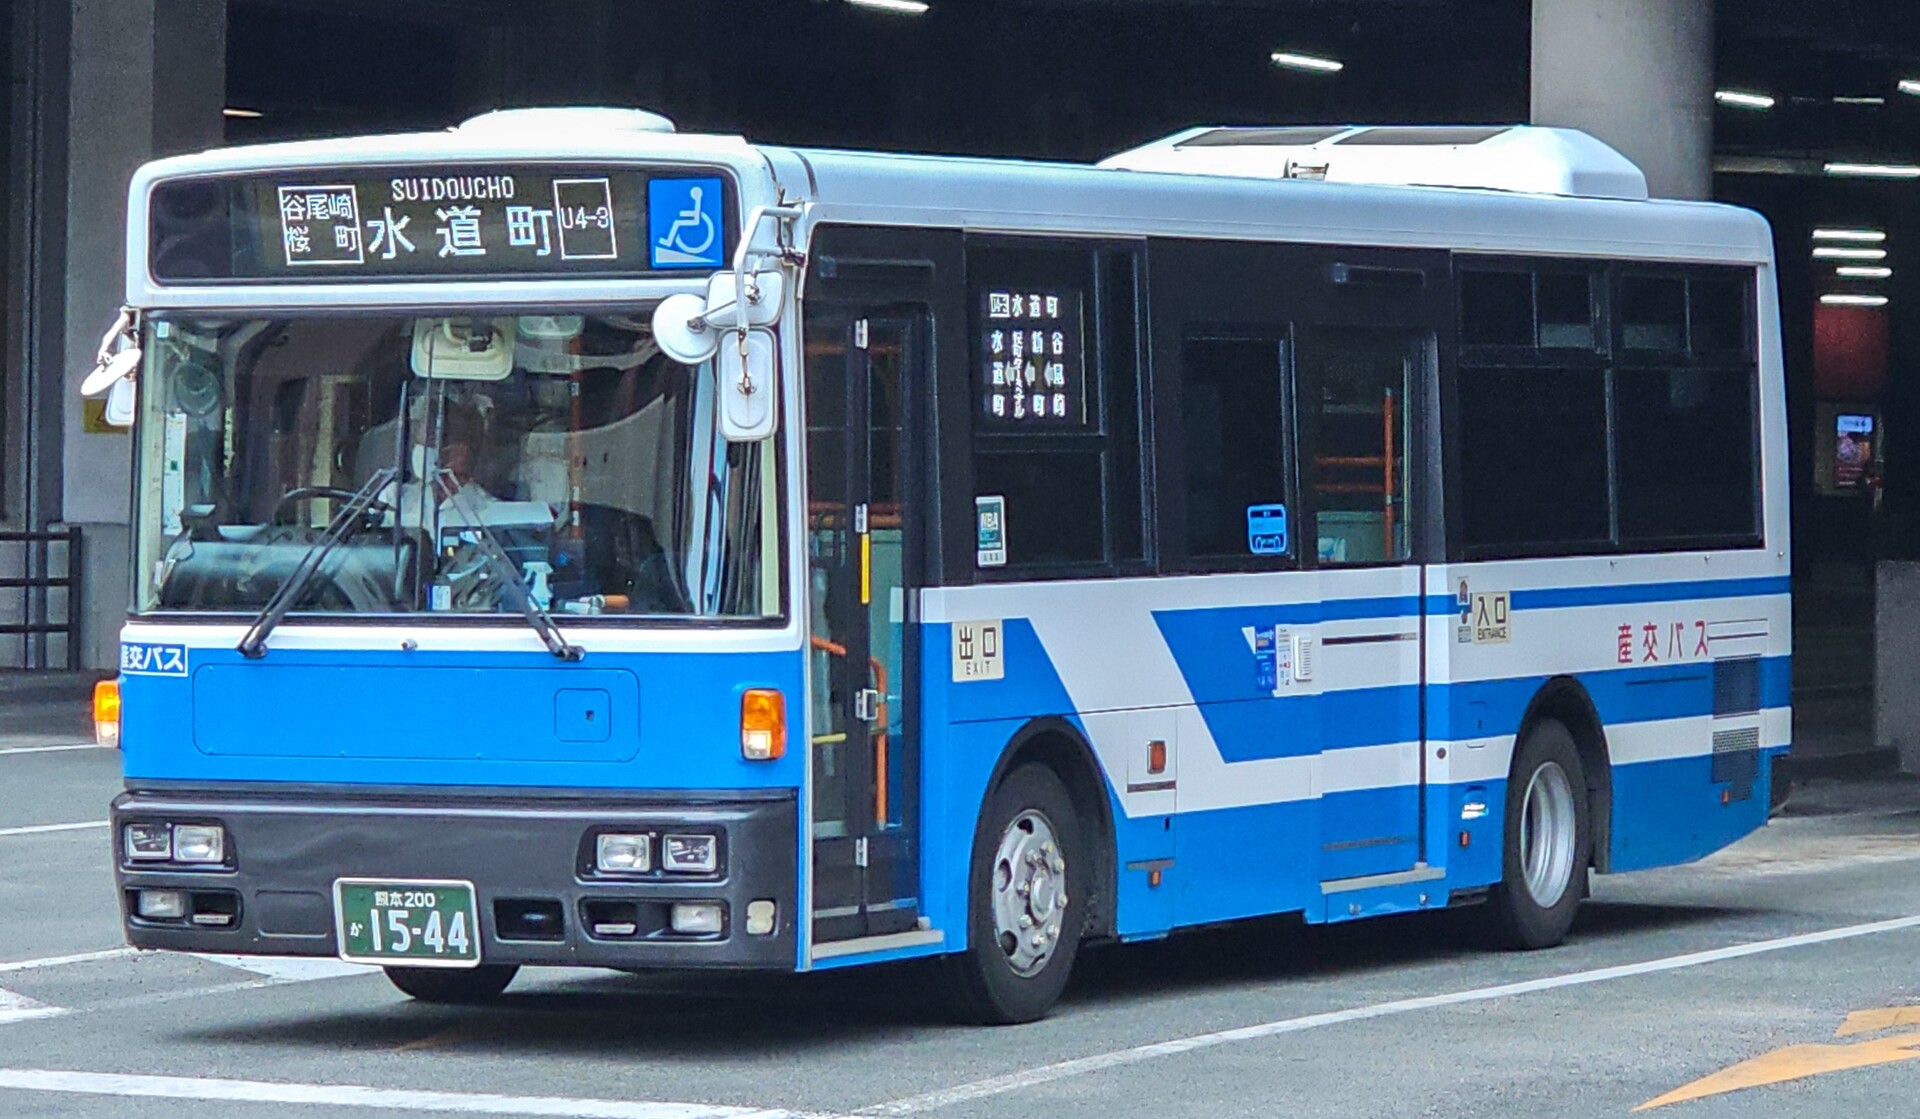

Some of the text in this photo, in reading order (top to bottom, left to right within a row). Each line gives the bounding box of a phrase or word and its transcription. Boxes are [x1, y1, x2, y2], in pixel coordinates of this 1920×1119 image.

[391, 177, 514, 201] SUIDOUCHO
[284, 194, 352, 220] 谷尾崎
[561, 206, 609, 229] U4-3
[366, 206, 553, 259] 水道町
[1477, 596, 1506, 626] 入口
[959, 626, 996, 660] 出口
[1618, 620, 1708, 664] 産交バス
[966, 660, 991, 675] EXIT
[370, 909, 469, 954] 15-44
